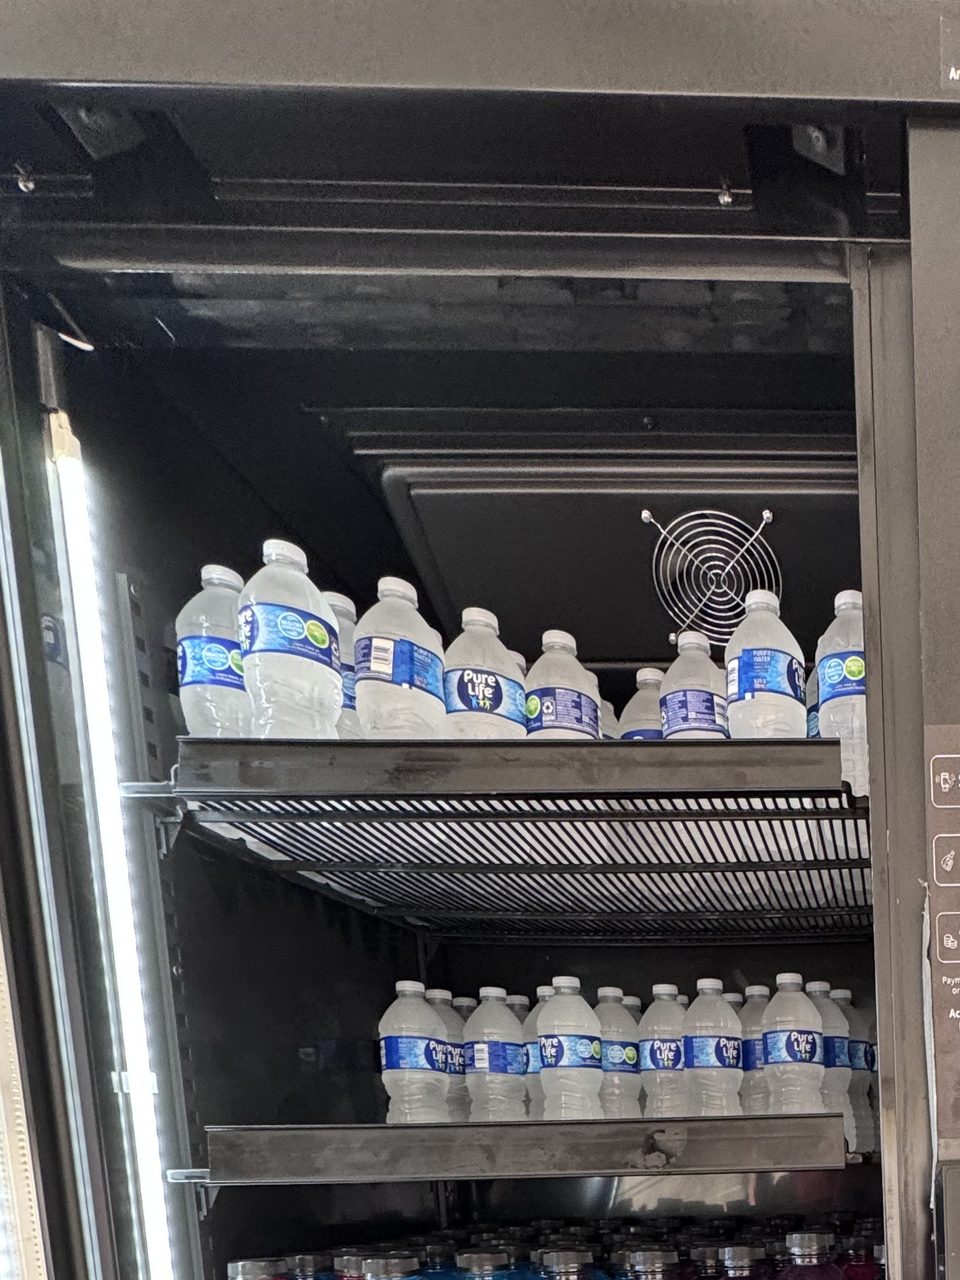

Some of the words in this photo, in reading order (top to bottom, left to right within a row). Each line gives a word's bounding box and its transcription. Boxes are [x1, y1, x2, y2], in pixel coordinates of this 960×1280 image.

[464, 670, 496, 686] Pure
[468, 683, 494, 699] Life
[541, 1036, 558, 1046] Pure
[790, 1031, 814, 1043] Pure
[653, 1040, 677, 1051] Pure
[719, 1038, 738, 1050] Pure
[794, 1041, 812, 1053] Life
[542, 1046, 556, 1057] Life
[656, 1049, 675, 1062] Life
[722, 1047, 738, 1060] Life
